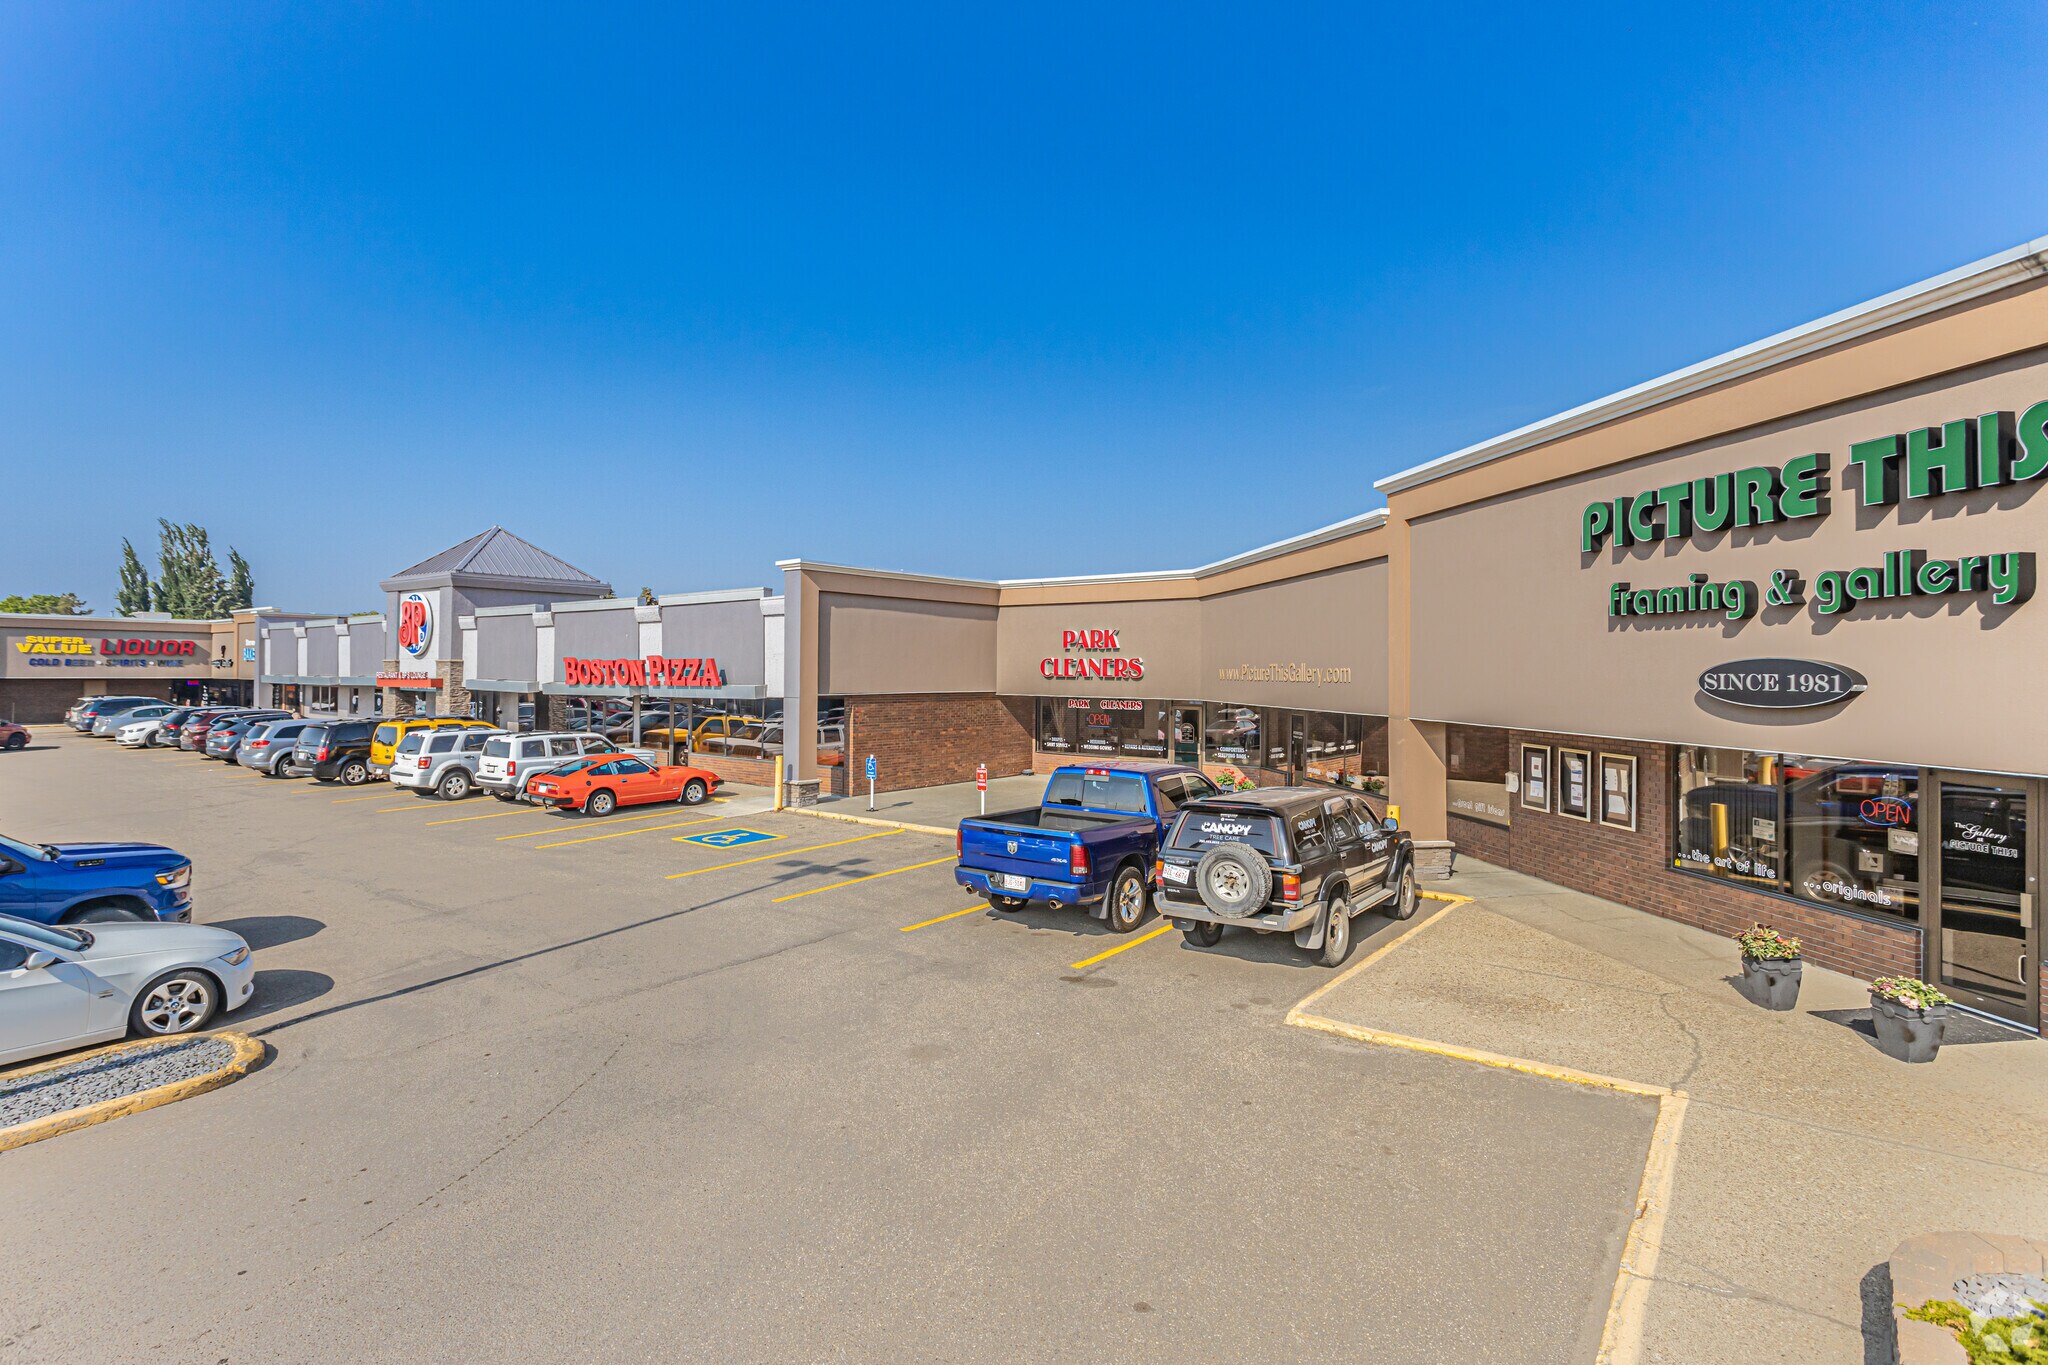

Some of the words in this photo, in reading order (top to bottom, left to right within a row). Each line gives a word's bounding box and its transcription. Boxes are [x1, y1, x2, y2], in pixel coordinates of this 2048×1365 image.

[1581, 453, 1824, 553] PICTURE
[1849, 400, 2048, 507] THIS
[1609, 573, 1748, 621] framing
[1766, 569, 1796, 607] &
[1815, 549, 2022, 616] gallery
[16, 643, 93, 654] VALUE
[25, 635, 84, 644] SUPER
[100, 639, 196, 656] LIQUOR
[1062, 629, 1119, 649] PARK
[28, 658, 61, 667] COLD
[105, 659, 147, 667] SPIRITS
[563, 656, 646, 686] BOSTON
[647, 655, 722, 687] PIZZA
[1040, 657, 1144, 678] CLEANERS
[1218, 662, 1351, 688] www.PictureThisGallery.com
[1704, 673, 1779, 692] SINCE
[1786, 674, 1844, 693] 1981
[1068, 699, 1090, 709] PARK
[1100, 700, 1143, 711] CLEANERS
[1088, 713, 1110, 726] OPEN
[1860, 799, 1910, 824] OPEN
[1201, 821, 1252, 836] CANOPY
[1298, 817, 1317, 831] CANOPY
[1962, 823, 2007, 844] Gallery
[1949, 839, 1990, 854] PICTURE
[1991, 845, 2018, 858] THIS!
[1714, 857, 1732, 869] art
[1736, 860, 1751, 873] of
[1754, 862, 1776, 879] life
